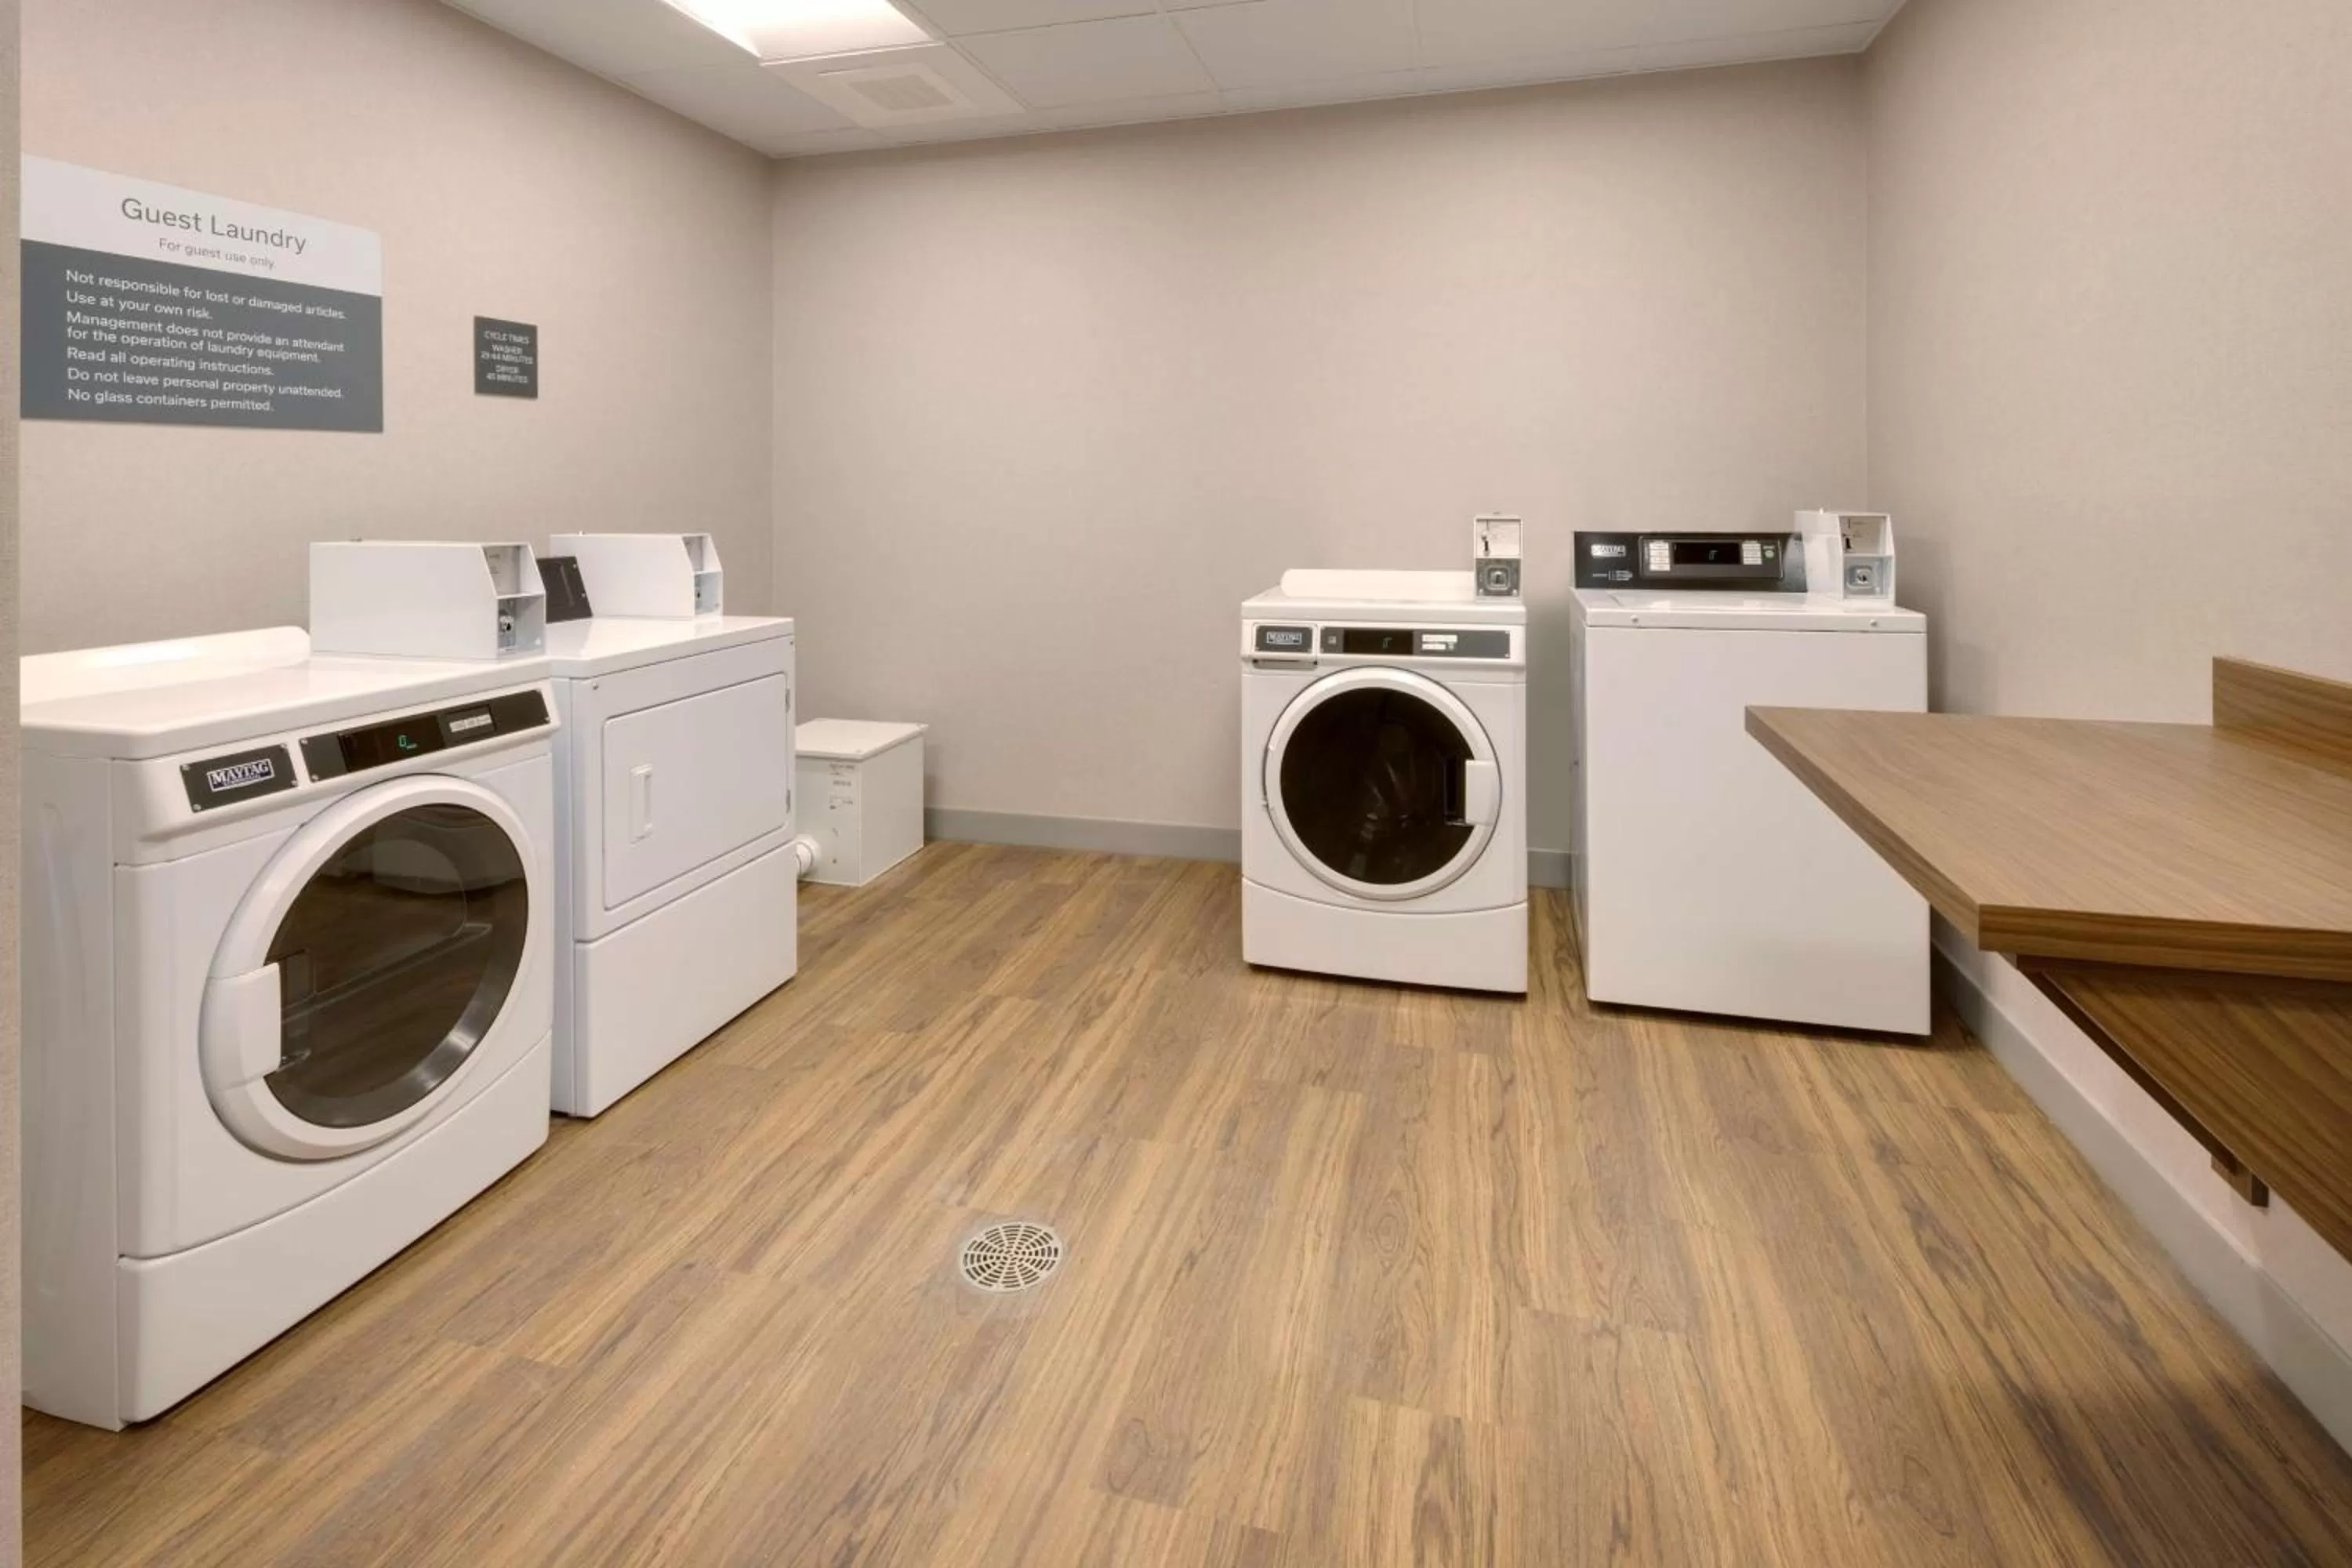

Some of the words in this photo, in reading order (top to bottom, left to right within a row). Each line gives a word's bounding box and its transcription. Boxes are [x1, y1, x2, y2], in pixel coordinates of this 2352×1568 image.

[122, 198, 201, 232] Guest
[211, 214, 306, 254] Laundry
[159, 238, 181, 251] For
[185, 245, 220, 260] guest
[225, 253, 246, 263] use
[66, 269, 94, 285] Not
[98, 277, 180, 296] responsible
[183, 286, 202, 299] for
[205, 289, 229, 303] lost
[232, 296, 245, 305] or
[249, 296, 302, 313] damaged
[66, 289, 96, 305] Use
[100, 296, 114, 307] at
[118, 300, 151, 312] your
[154, 304, 183, 316] own
[187, 306, 213, 320] risk.
[66, 311, 162, 332] Management
[165, 323, 198, 336] does
[202, 328, 223, 339] not
[227, 331, 272, 344] provide
[274, 336, 289, 346] an
[292, 338, 345, 352] attendant
[67, 326, 88, 339] for
[93, 329, 117, 343] the
[122, 334, 187, 350] operation
[191, 339, 205, 351] of
[207, 341, 255, 358] laundry
[256, 347, 322, 363] equipment.
[67, 346, 106, 361] Read
[110, 350, 126, 363] all
[129, 354, 196, 371] operating
[199, 358, 274, 375] instructions.
[67, 368, 89, 380] Do
[94, 371, 119, 383] not
[123, 371, 159, 386] leave
[163, 376, 219, 390] personal
[223, 380, 275, 395] property
[278, 385, 343, 399] unattended.
[67, 388, 90, 401] No
[94, 390, 132, 405] glass
[136, 394, 207, 408] containers
[210, 398, 274, 412] permitted.
[212, 760, 268, 785] MAYTAG
